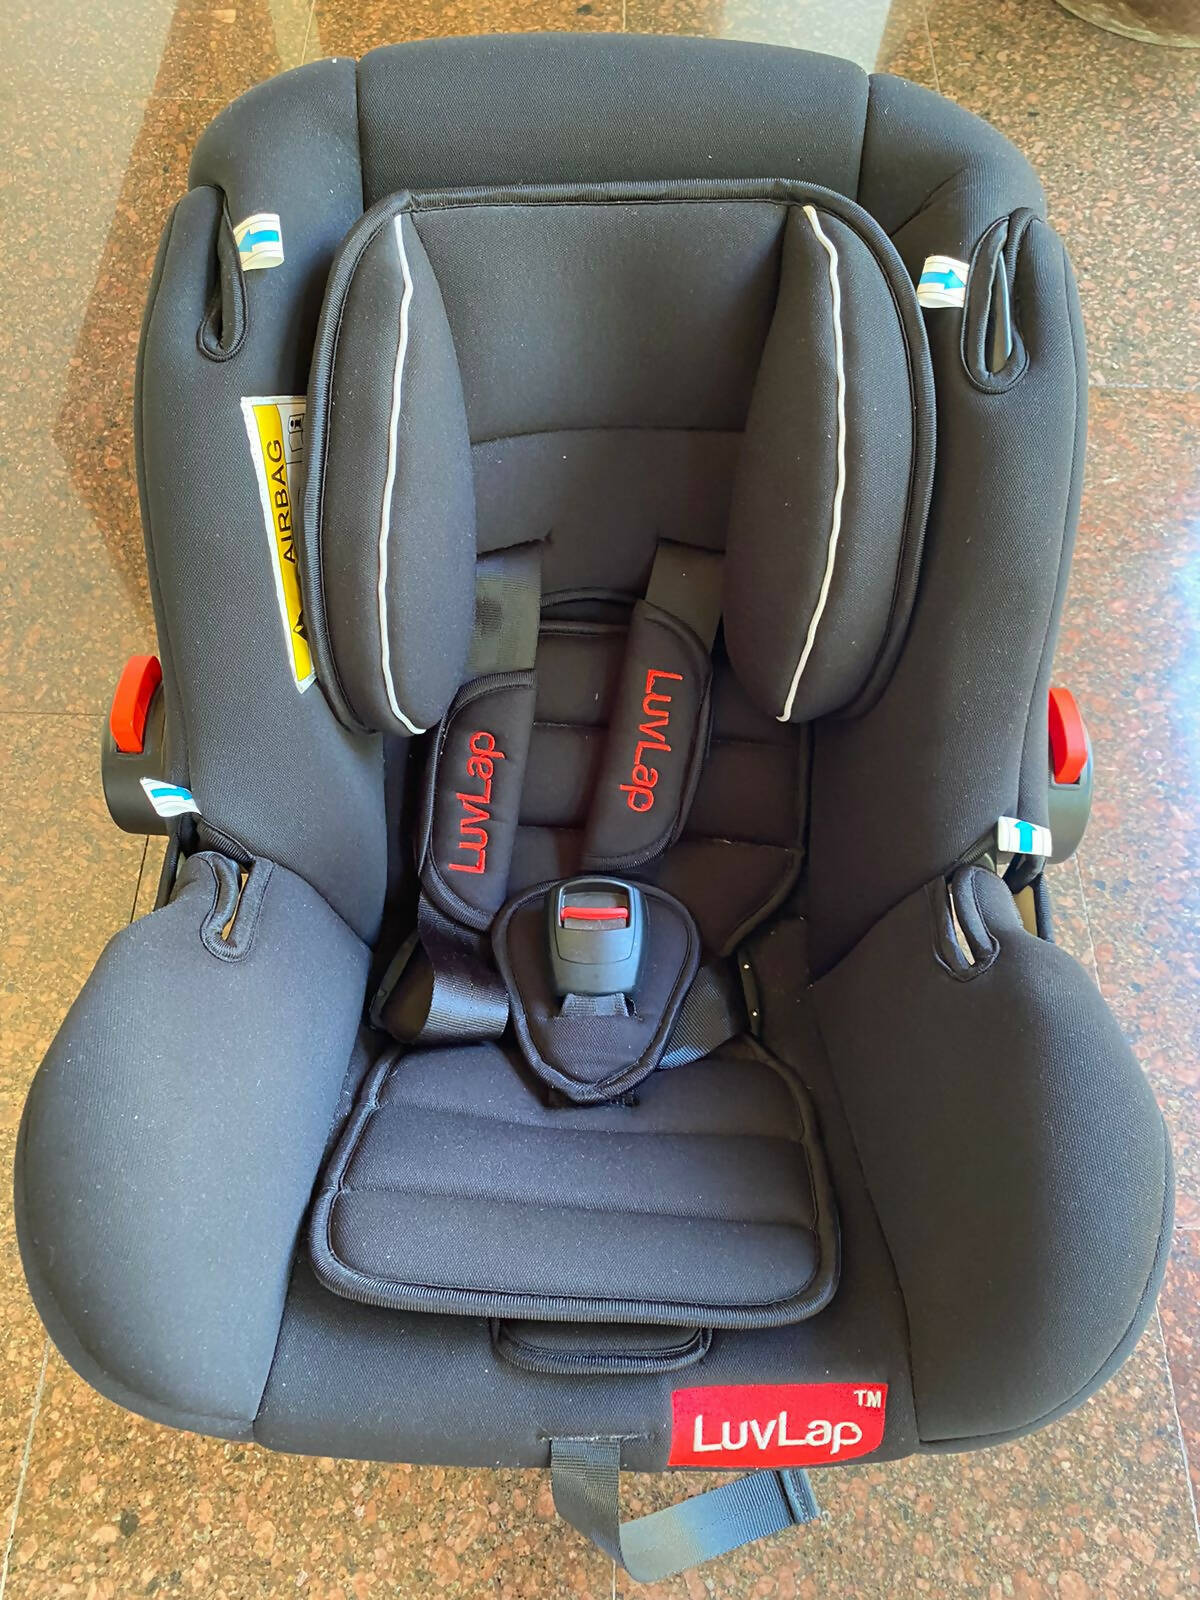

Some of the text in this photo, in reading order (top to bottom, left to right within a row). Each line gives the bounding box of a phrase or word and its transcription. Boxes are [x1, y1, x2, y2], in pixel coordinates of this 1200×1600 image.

[266, 439, 298, 565] AIRBAG
[448, 730, 507, 875] LuvLap
[618, 668, 684, 813] LuvLap
[692, 1410, 863, 1456] LuvLap
[853, 1388, 882, 1409] TM
